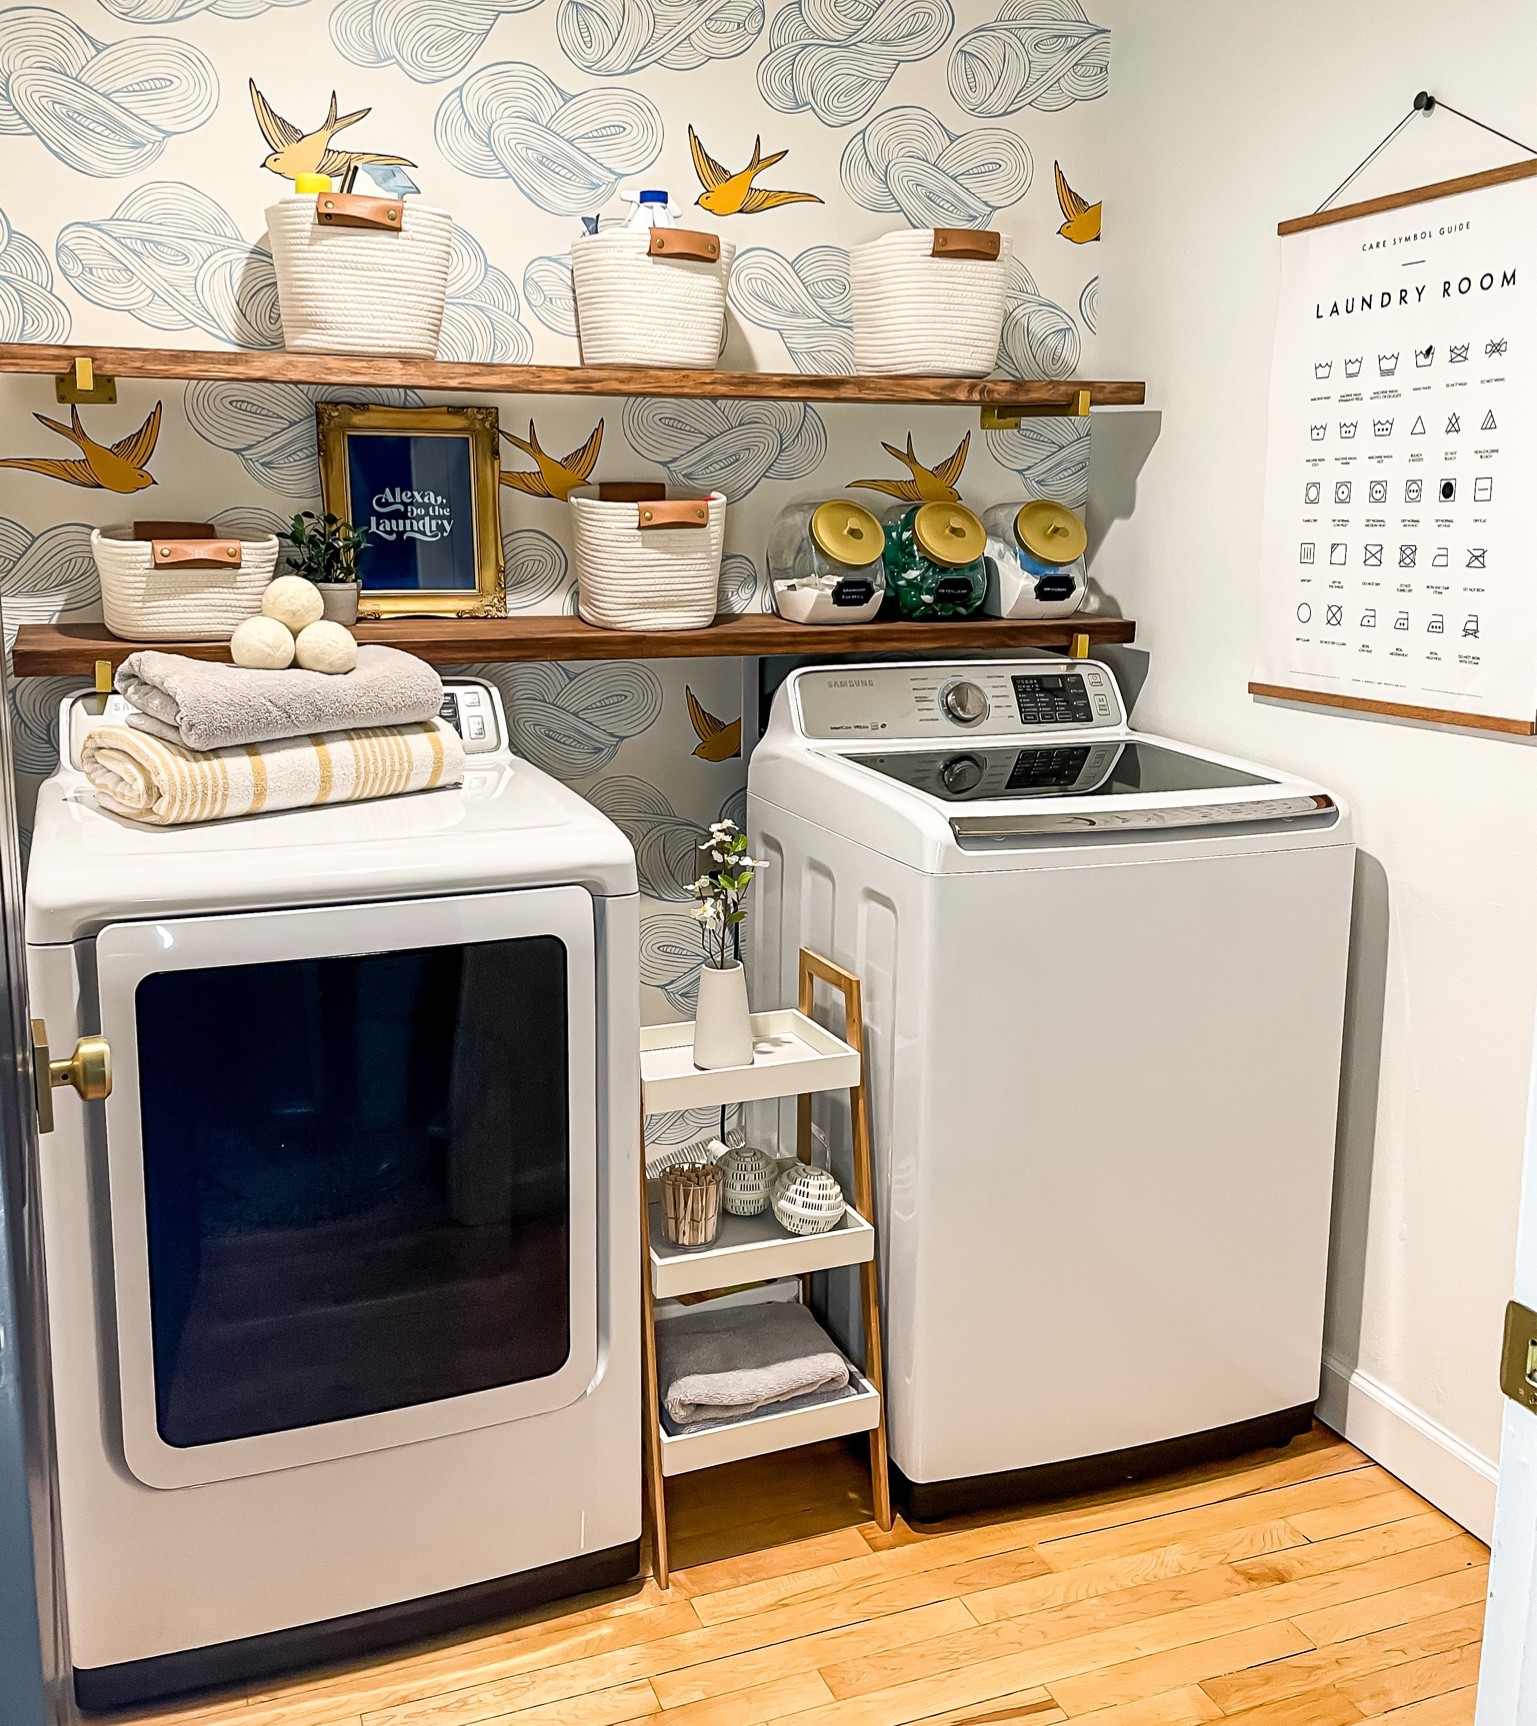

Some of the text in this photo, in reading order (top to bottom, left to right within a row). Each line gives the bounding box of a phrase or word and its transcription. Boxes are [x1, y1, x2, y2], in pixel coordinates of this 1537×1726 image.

[1362, 221, 1470, 252] CARE SYMBOL GUIDE
[1316, 268, 1516, 320] LAUNDRY ROOM
[372, 487, 446, 513] Alexa,
[407, 505, 450, 518] Do the
[368, 516, 454, 541] Laundry
[827, 680, 874, 688] SAMSUNG
